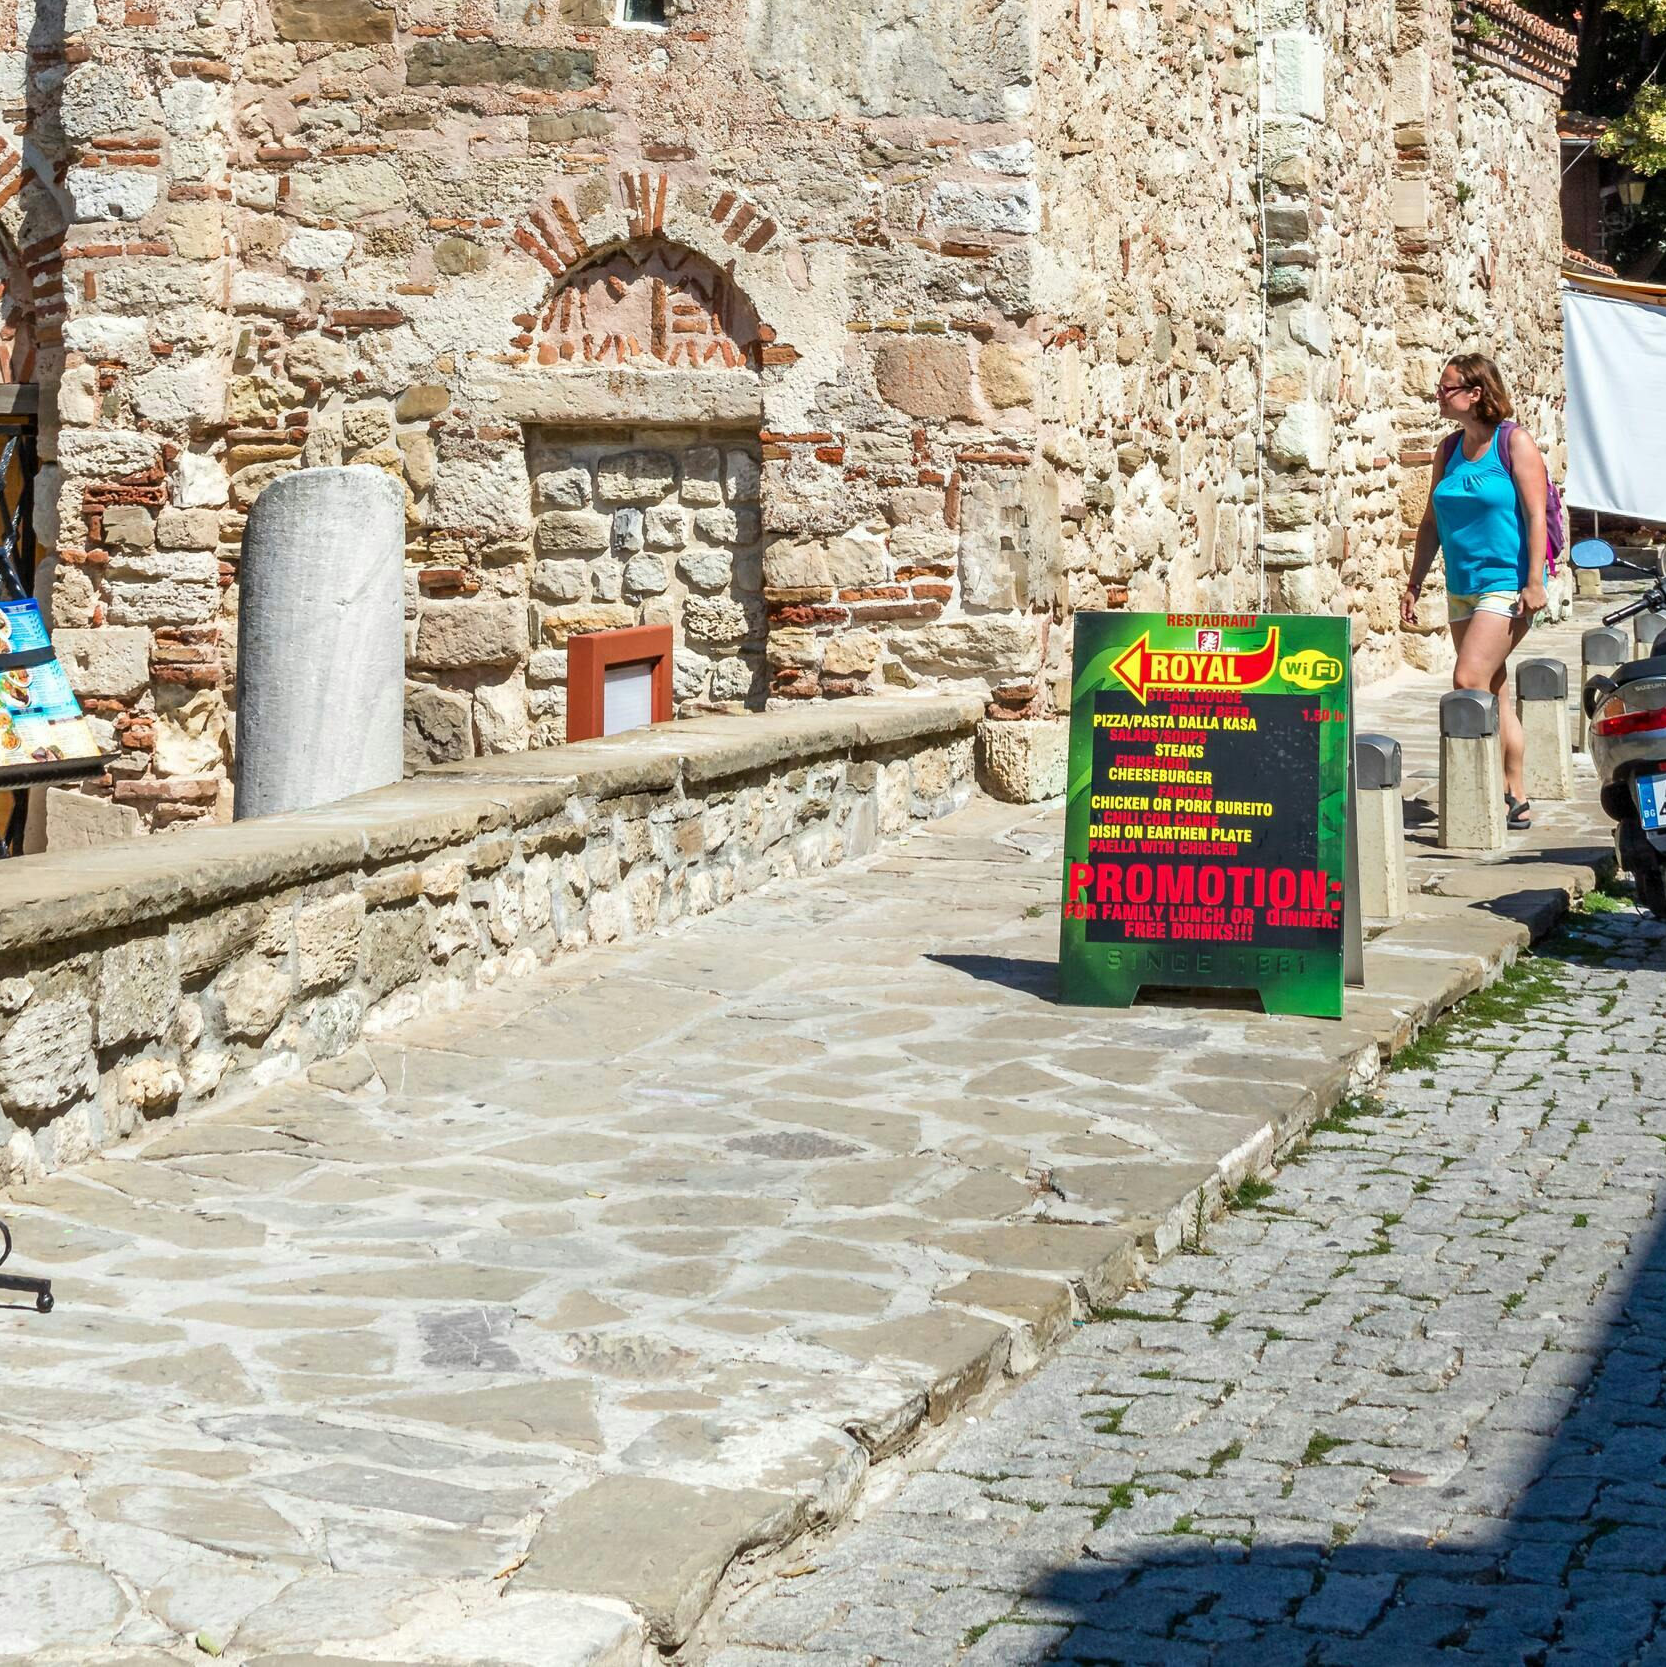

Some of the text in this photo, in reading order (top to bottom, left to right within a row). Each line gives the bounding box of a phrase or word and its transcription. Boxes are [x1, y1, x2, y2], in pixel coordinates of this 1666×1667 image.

[1166, 614, 1257, 628] RESTAURANT
[1151, 655, 1242, 683] ROYAL
[1634, 682, 1666, 692] SUZUKI
[1147, 689, 1242, 704] STEAK HOUSE
[1170, 704, 1250, 718] DRAFT BEER
[1301, 709, 1330, 722] 1.50
[1093, 714, 1257, 731] PIZZA/PASTA DALLA KASA
[1109, 729, 1207, 744] SALADS/SOUPS
[1155, 743, 1204, 758] STEAKS
[1108, 768, 1213, 784] CHEESEBURGER
[1091, 796, 1149, 810] CHICKEN
[1153, 797, 1171, 811] OR
[1175, 798, 1212, 813] PORK
[1103, 811, 1219, 827] CHILI CON CARNE
[1643, 809, 1656, 818] BG
[1089, 824, 1253, 843] DISH ON EARTHEN PLATE
[1089, 838, 1238, 856] PAELLA WITH CHICKEN
[1068, 862, 1342, 911] PROMOTION:
[1065, 902, 1097, 920] FOR
[1102, 903, 1164, 921] FAMILY
[1169, 905, 1225, 924] LUNCH
[1231, 908, 1254, 925] OR
[1124, 923, 1253, 941] FREE DRINKS!!!
[1106, 949, 1213, 973] SINCE
